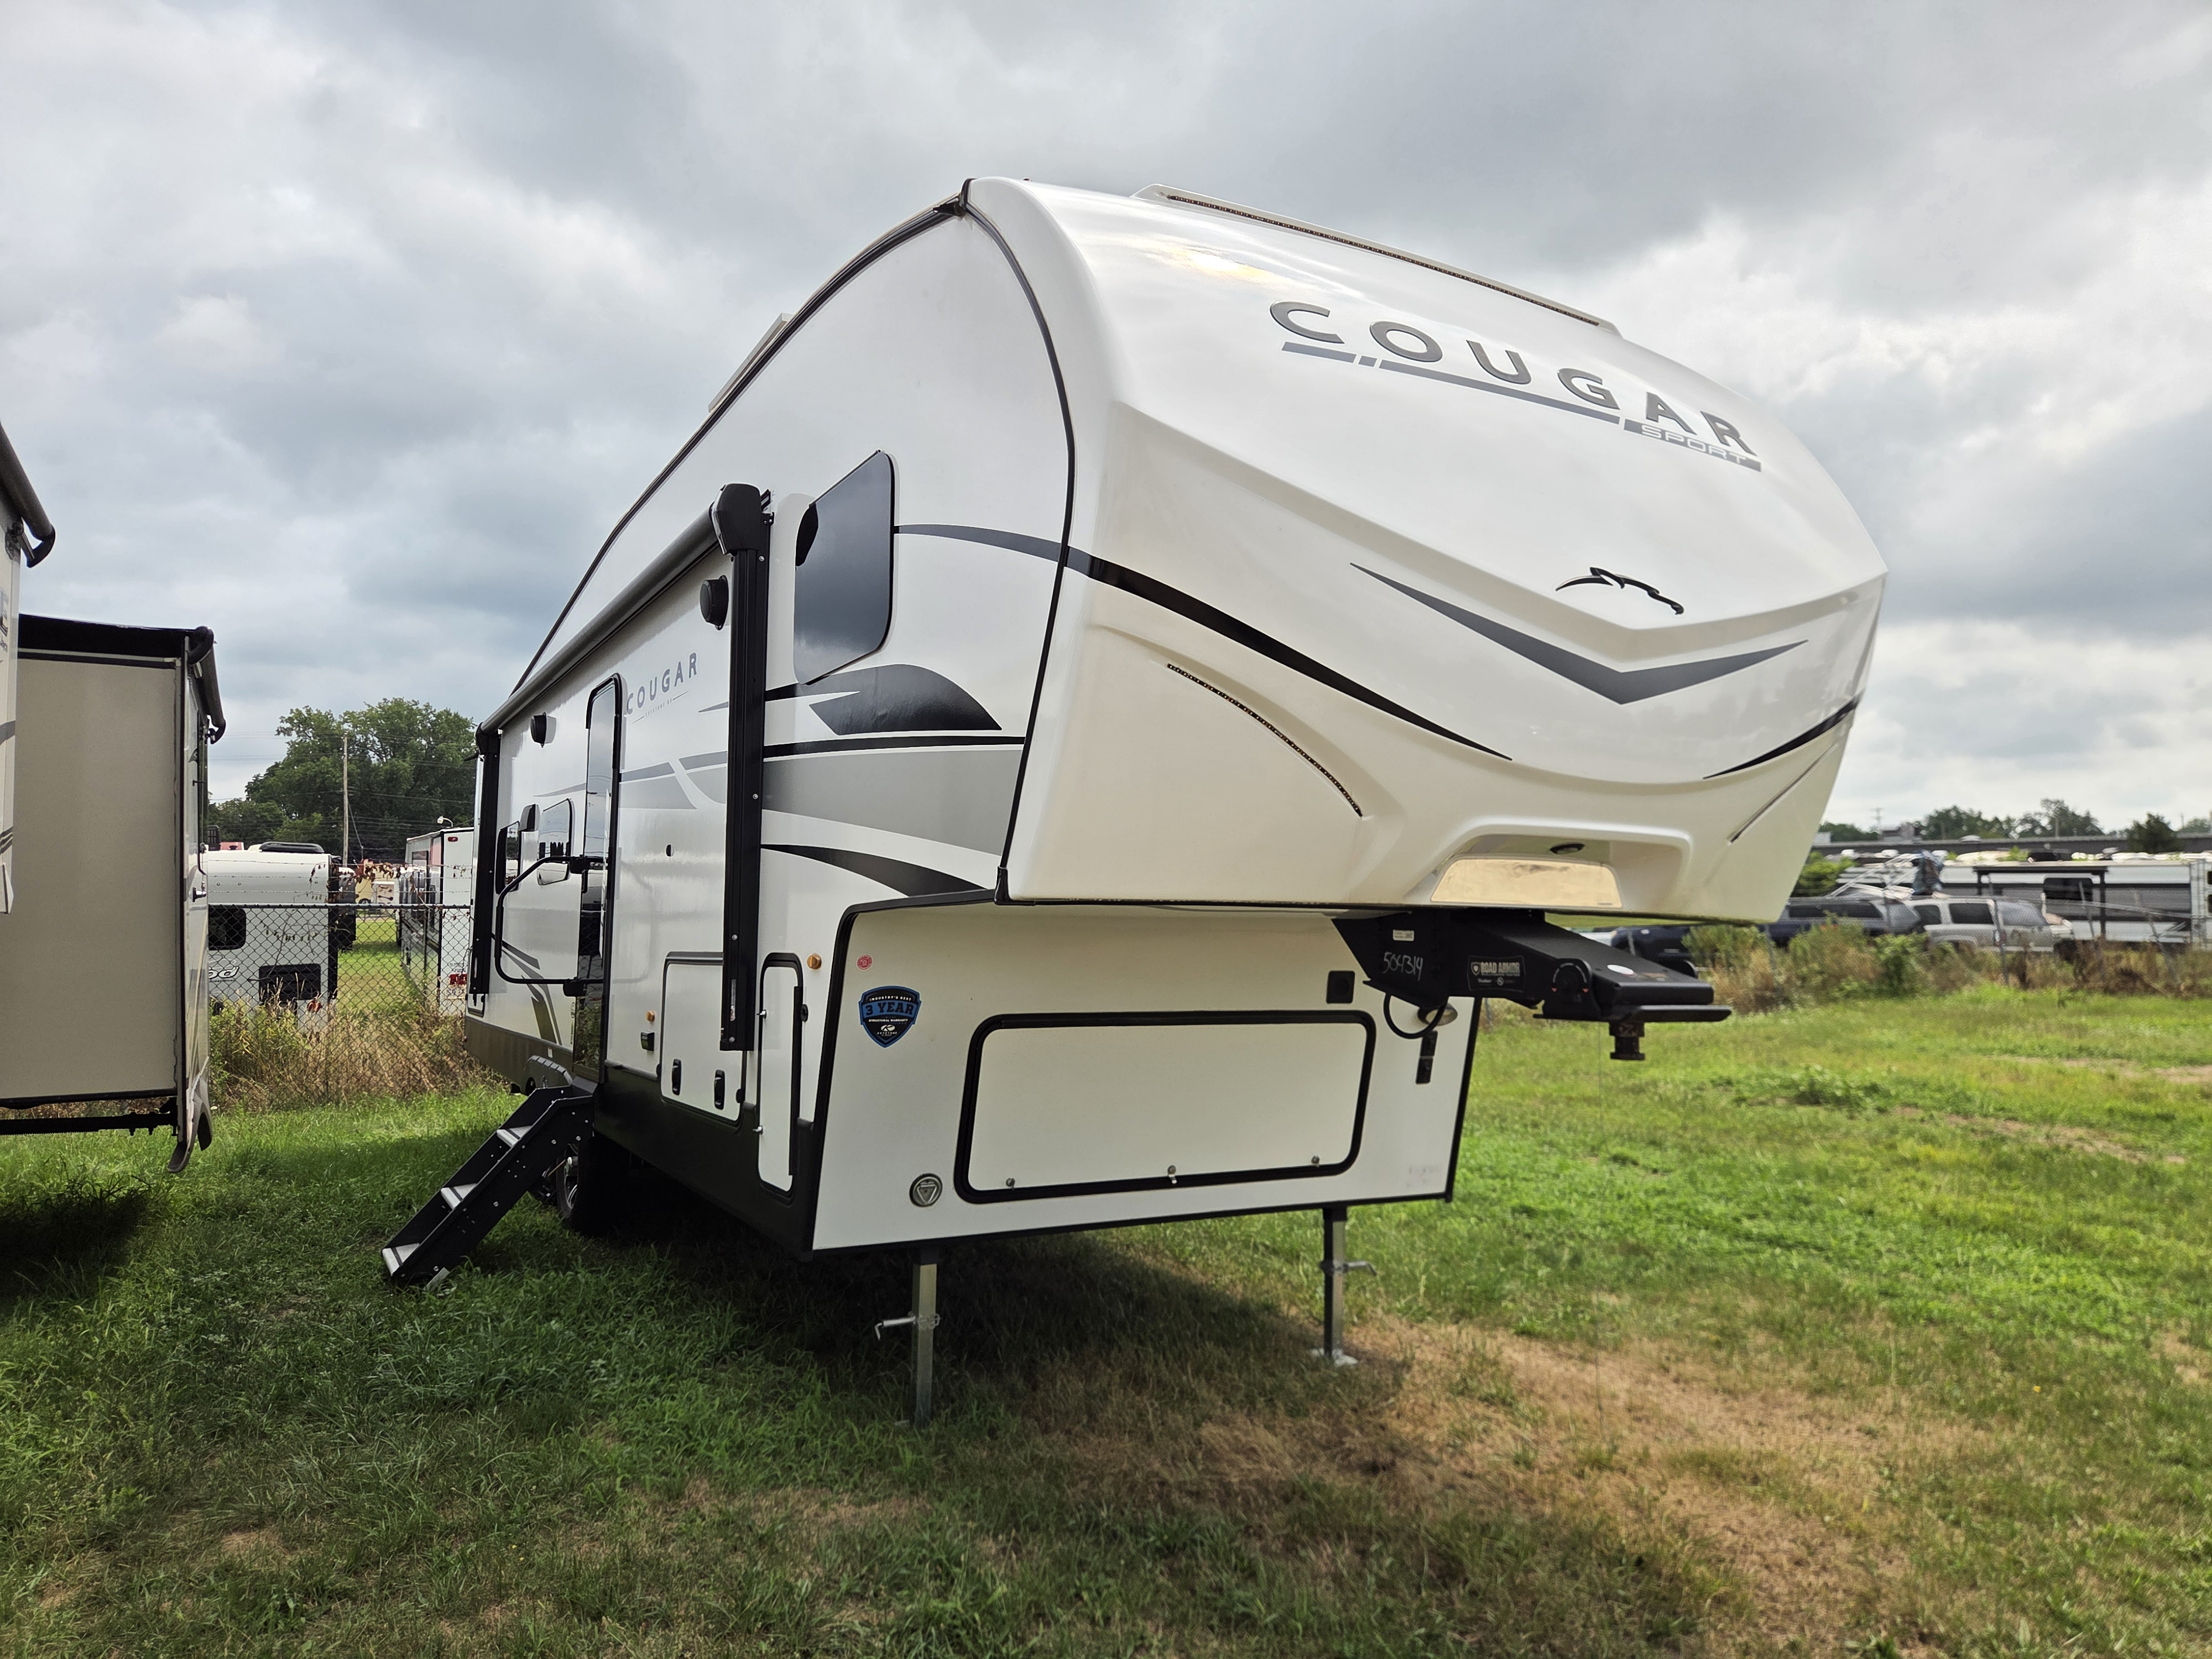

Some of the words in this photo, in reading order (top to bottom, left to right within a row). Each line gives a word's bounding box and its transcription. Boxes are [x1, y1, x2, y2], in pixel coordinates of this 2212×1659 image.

[1270, 301, 1759, 457] COUGAR
[1641, 424, 1747, 464] SPORT
[626, 653, 697, 714] COUGAR
[865, 1005, 873, 1015] 3
[878, 1001, 914, 1015] YEAR
